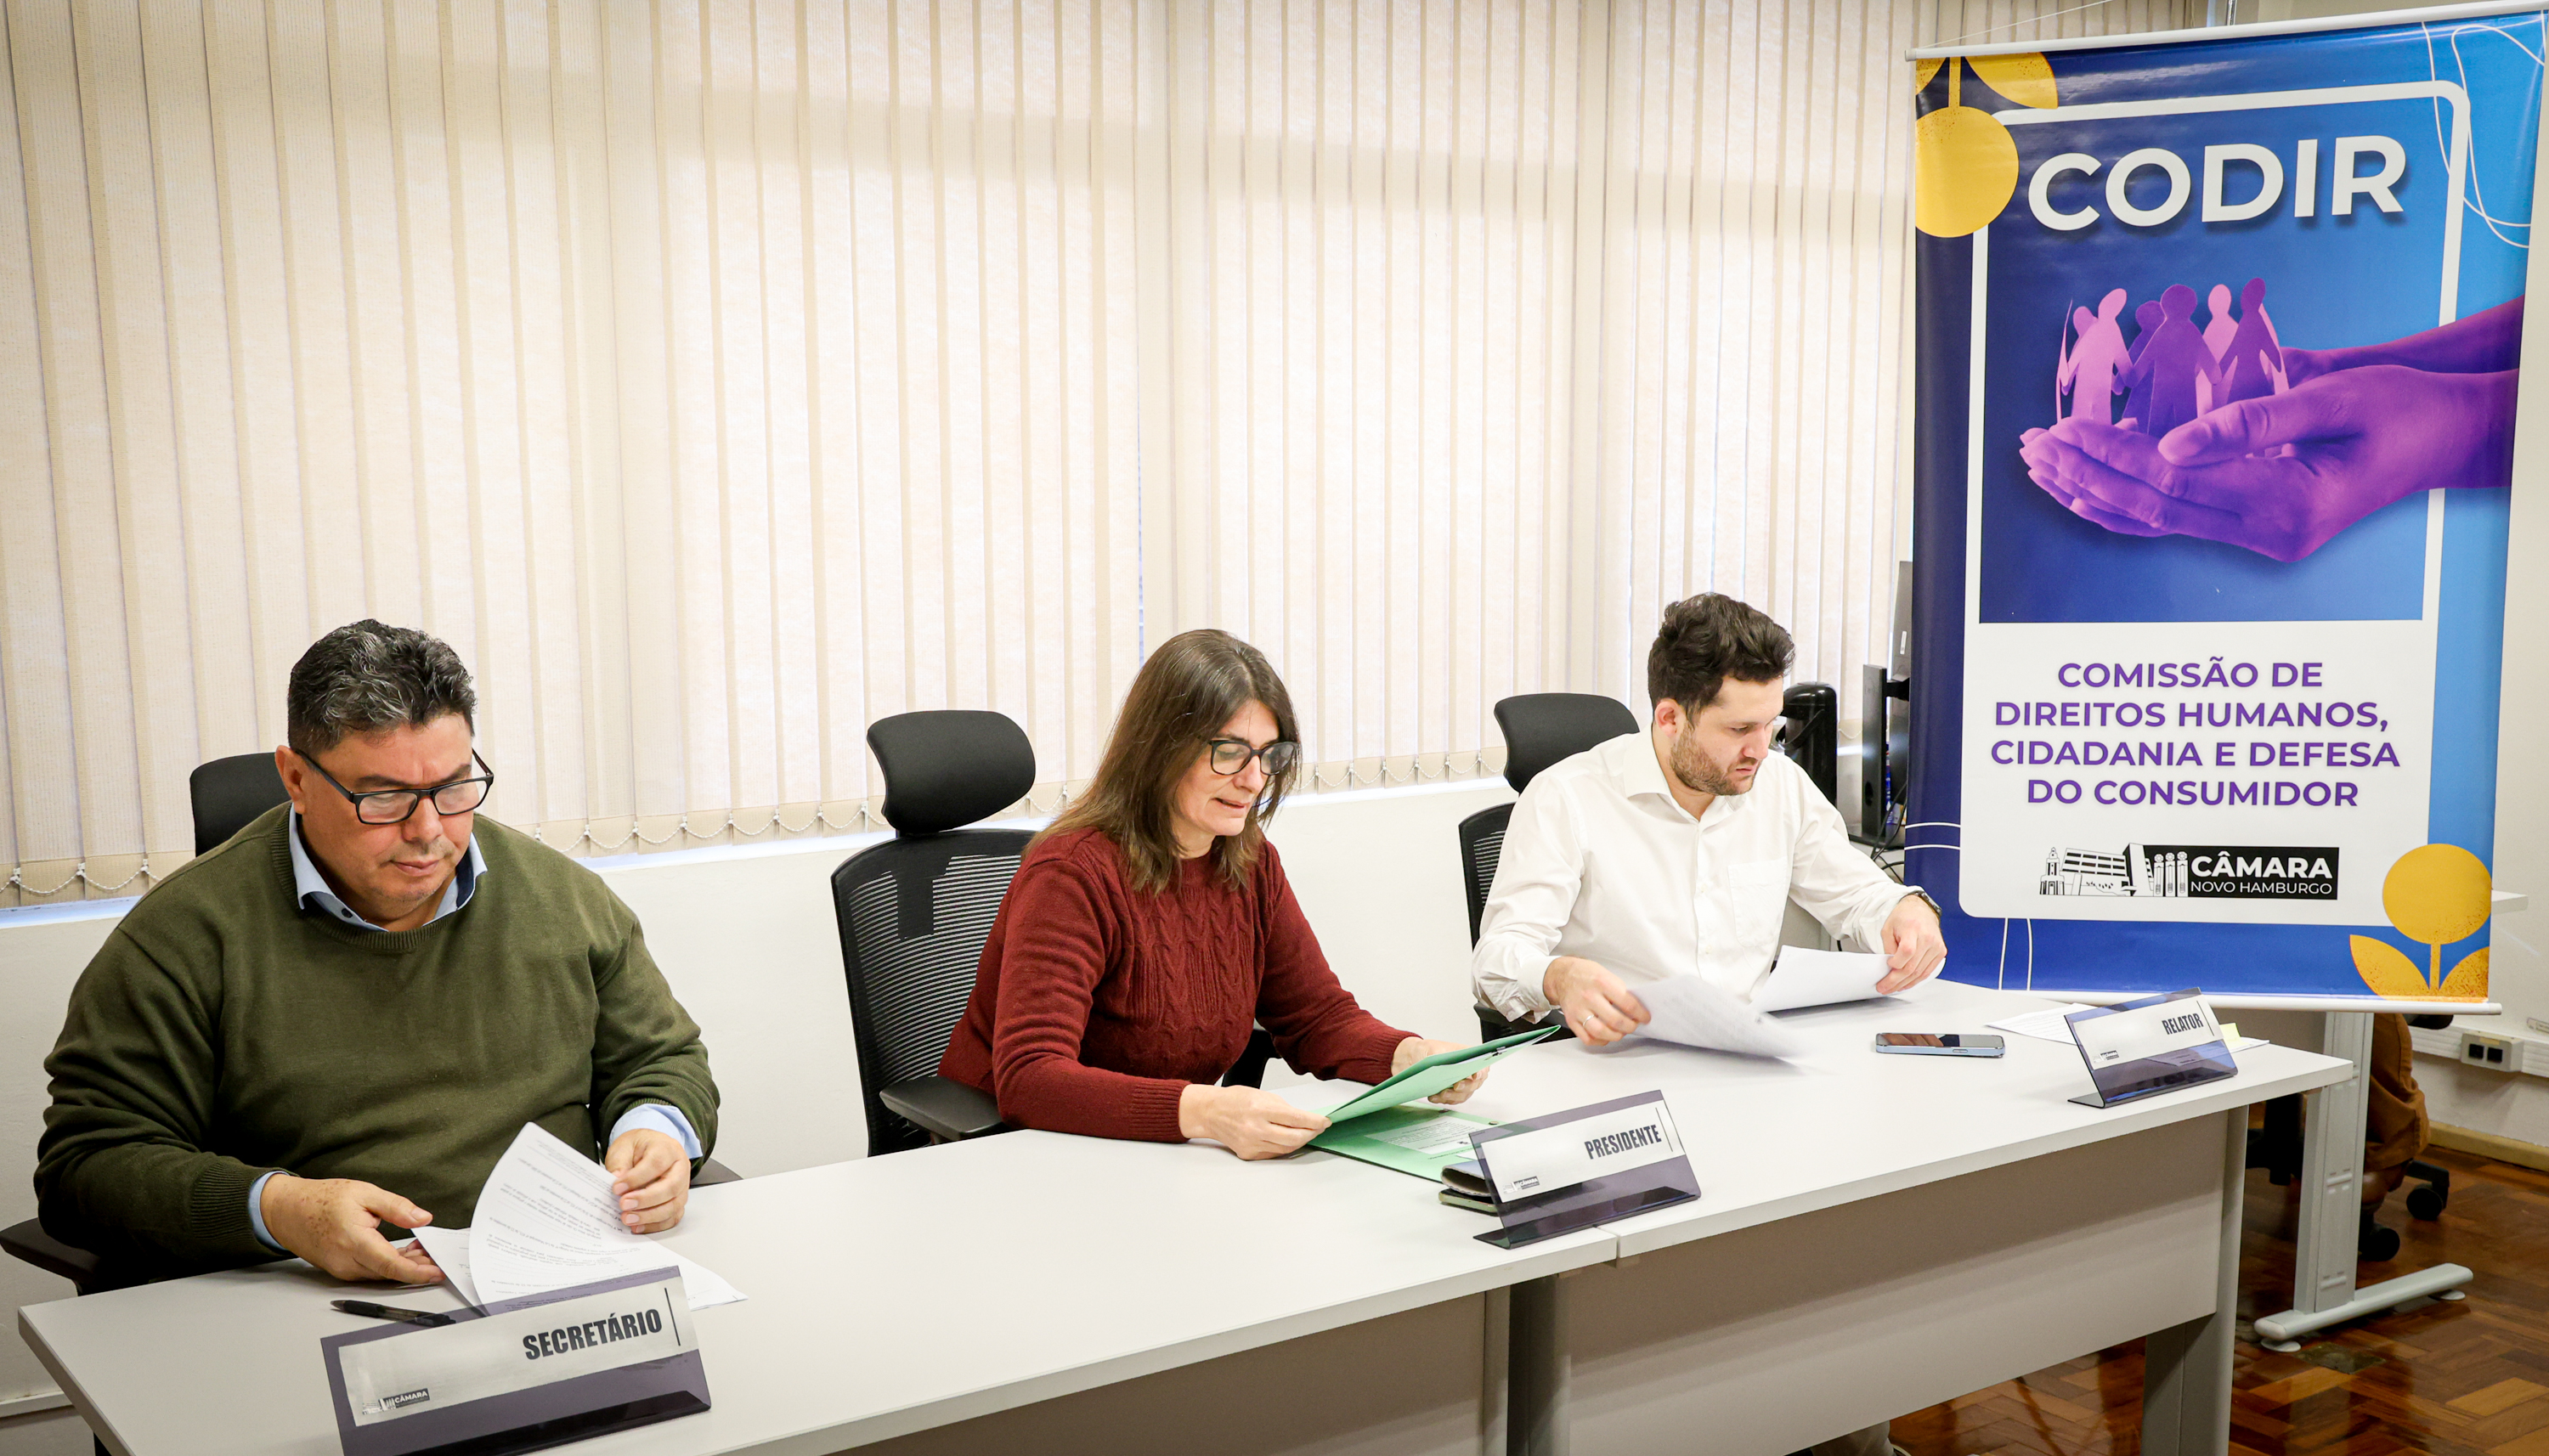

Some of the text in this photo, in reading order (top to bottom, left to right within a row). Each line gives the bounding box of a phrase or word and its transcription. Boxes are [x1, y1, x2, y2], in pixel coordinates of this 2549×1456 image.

[2028, 135, 2406, 231] CODIR
[2058, 656, 2323, 688] COMISSÃO DE
[1995, 701, 2388, 732] DIREITOS HUMANOS,
[1991, 740, 2400, 767] CIDADANIA E DEFESA
[2028, 779, 2358, 806] DO CONSUMIDOR
[2190, 850, 2333, 879] CÂMARA
[2190, 881, 2332, 894] NOVO HAMBURGO
[2162, 1013, 2204, 1035] RELATOR
[1584, 1124, 1662, 1160] PRESIDENTE
[523, 1309, 663, 1360] SECRETÁRIO
[394, 1391, 428, 1404] CÂMARA
